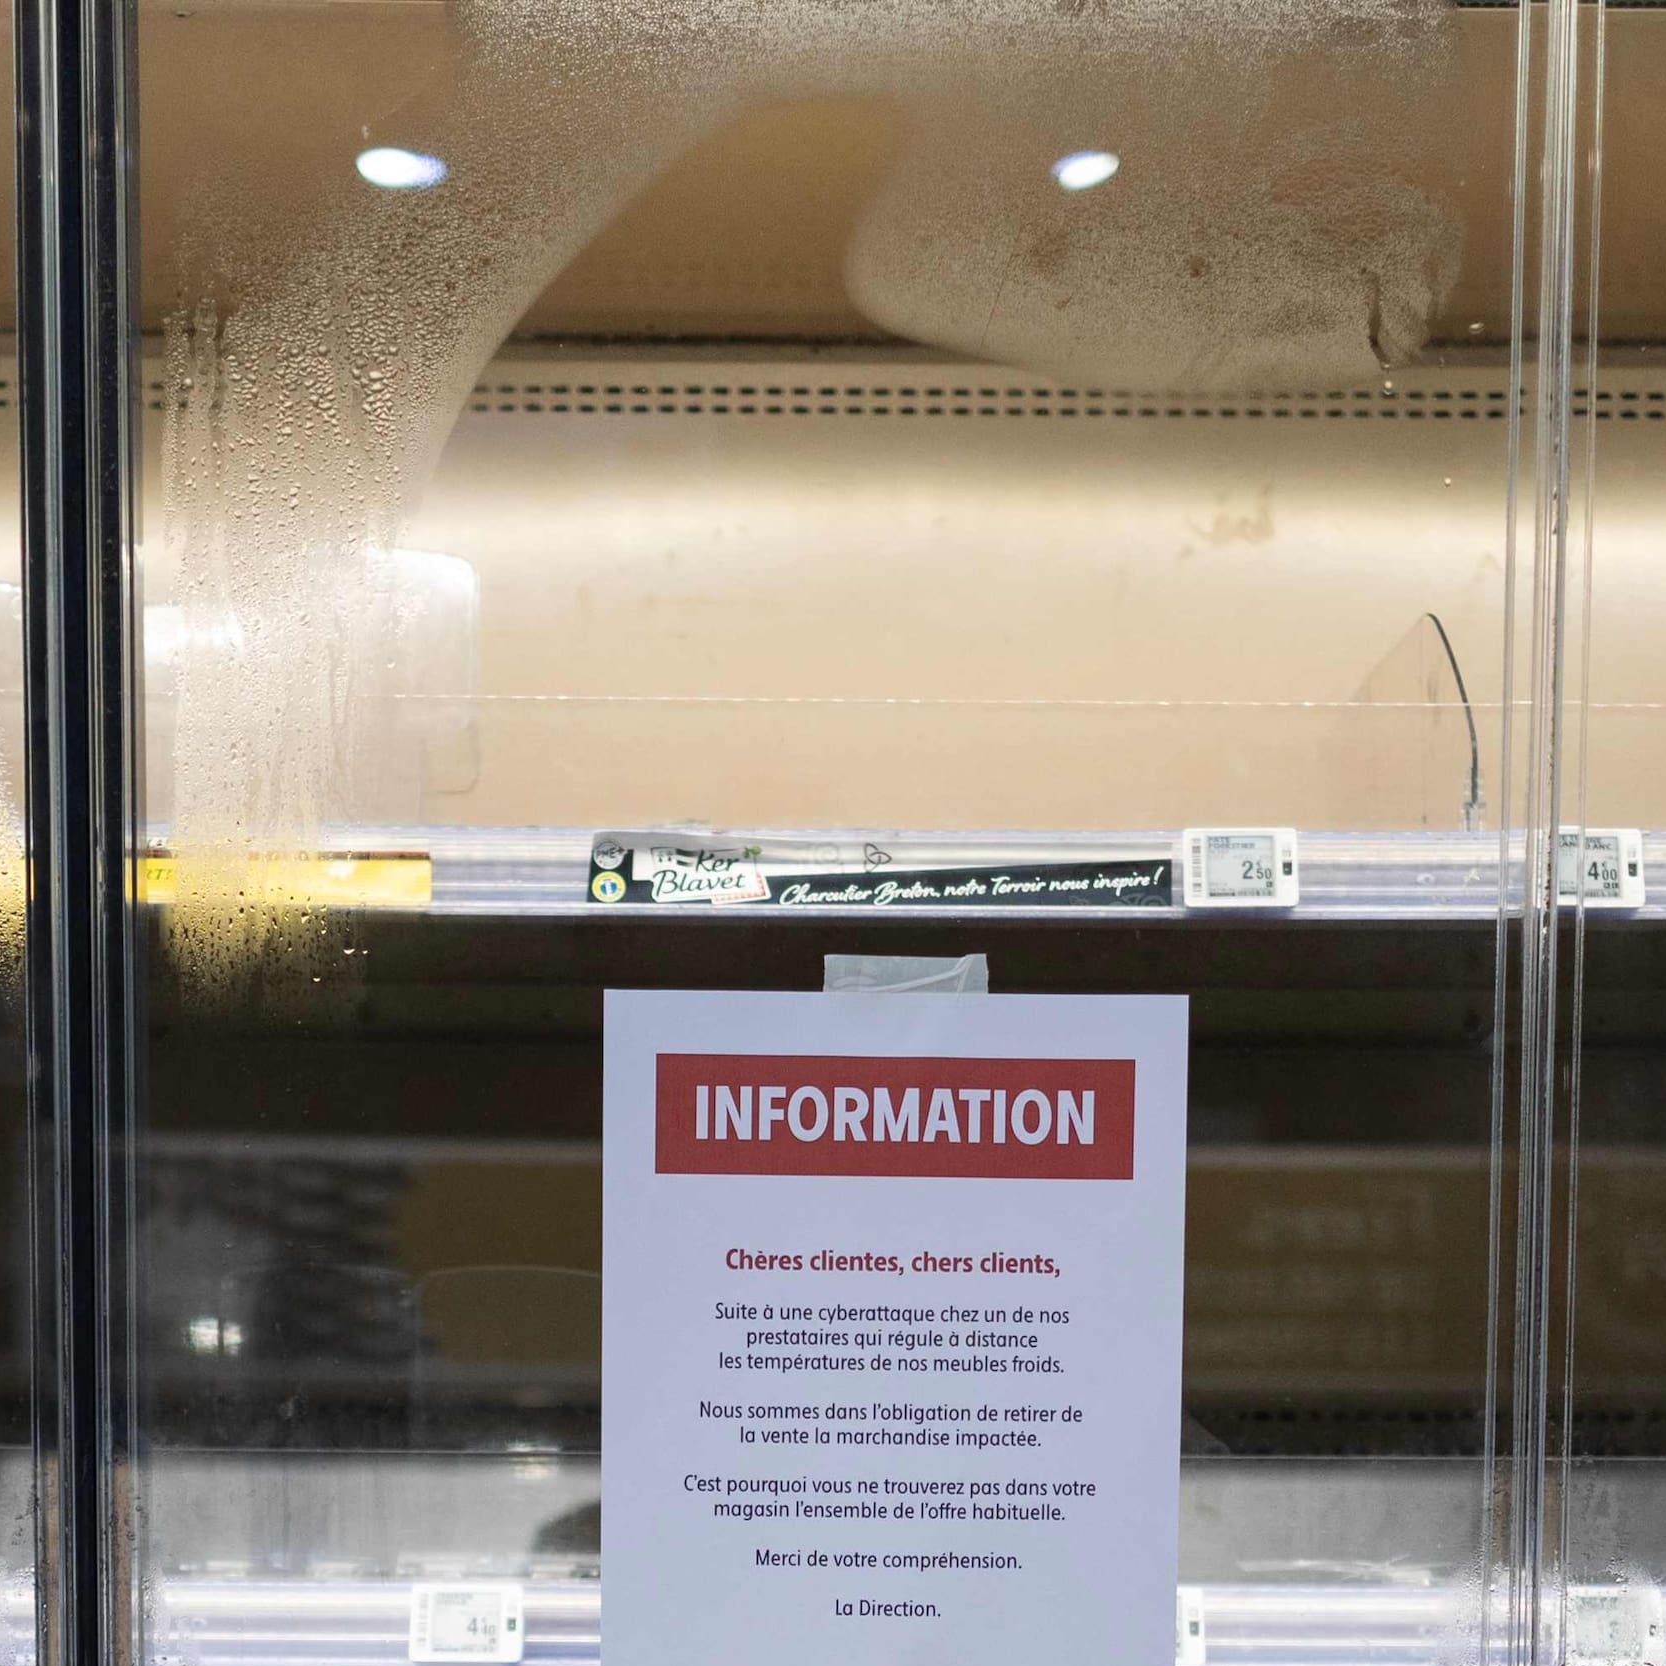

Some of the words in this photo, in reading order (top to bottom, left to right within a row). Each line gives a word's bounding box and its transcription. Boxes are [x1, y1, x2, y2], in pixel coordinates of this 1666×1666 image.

[695, 849, 740, 872] Ker
[652, 869, 746, 897] Blavet
[779, 883, 873, 905] Charcutier
[944, 878, 986, 896] notre
[991, 876, 1046, 895] Terroir
[1049, 878, 1089, 891] nous
[695, 1084, 1096, 1145] INFORMATION
[725, 1248, 804, 1271] Chères
[809, 1249, 905, 1277] clientes,
[911, 1250, 974, 1273] chers
[979, 1251, 1061, 1279] clients,
[714, 1301, 758, 1321] Suite
[762, 1303, 774, 1321] à
[779, 1306, 813, 1321] une
[818, 1303, 936, 1327] cyberattaque
[940, 1304, 980, 1323] chez
[984, 1309, 1007, 1323] un
[1012, 1305, 1034, 1324] de
[1039, 1310, 1070, 1325] nos
[746, 1328, 849, 1349] prestataires
[853, 1328, 883, 1351] qui
[887, 1329, 944, 1351] régule
[948, 1330, 960, 1348] à
[965, 1329, 1038, 1349] distance
[719, 1351, 743, 1370] les
[746, 1353, 866, 1374] températures
[869, 1353, 892, 1372] de
[897, 1358, 928, 1372] nos
[933, 1354, 1008, 1373] meubles
[1011, 1354, 1065, 1374] froids.
[699, 1400, 743, 1419] Nous
[747, 1405, 820, 1420] sommes
[824, 1402, 868, 1421] dans
[976, 1403, 999, 1422] de
[1004, 1404, 1058, 1423] retirer
[1061, 1404, 1083, 1423] de
[740, 1425, 756, 1444] la
[760, 1427, 810, 1445] vente
[814, 1426, 831, 1445] la
[836, 1427, 950, 1446] marchandise
[955, 1428, 1042, 1450] impactée.
[726, 1475, 807, 1497] pourquoi
[811, 1480, 853, 1494] vous
[857, 1480, 879, 1495] ne
[883, 1478, 965, 1496] trouverez
[969, 1482, 1001, 1500] pas
[1004, 1478, 1048, 1497] dans
[1051, 1480, 1097, 1497] votre
[713, 1499, 790, 1522] magasin
[892, 1501, 915, 1520] de
[972, 1502, 1066, 1521] habituelle.
[755, 1548, 801, 1567] Merci
[806, 1549, 829, 1568] de
[832, 1551, 878, 1568] votre
[882, 1551, 1023, 1570] compréhension.
[835, 1598, 854, 1617] La
[859, 1598, 942, 1618] Direction.
